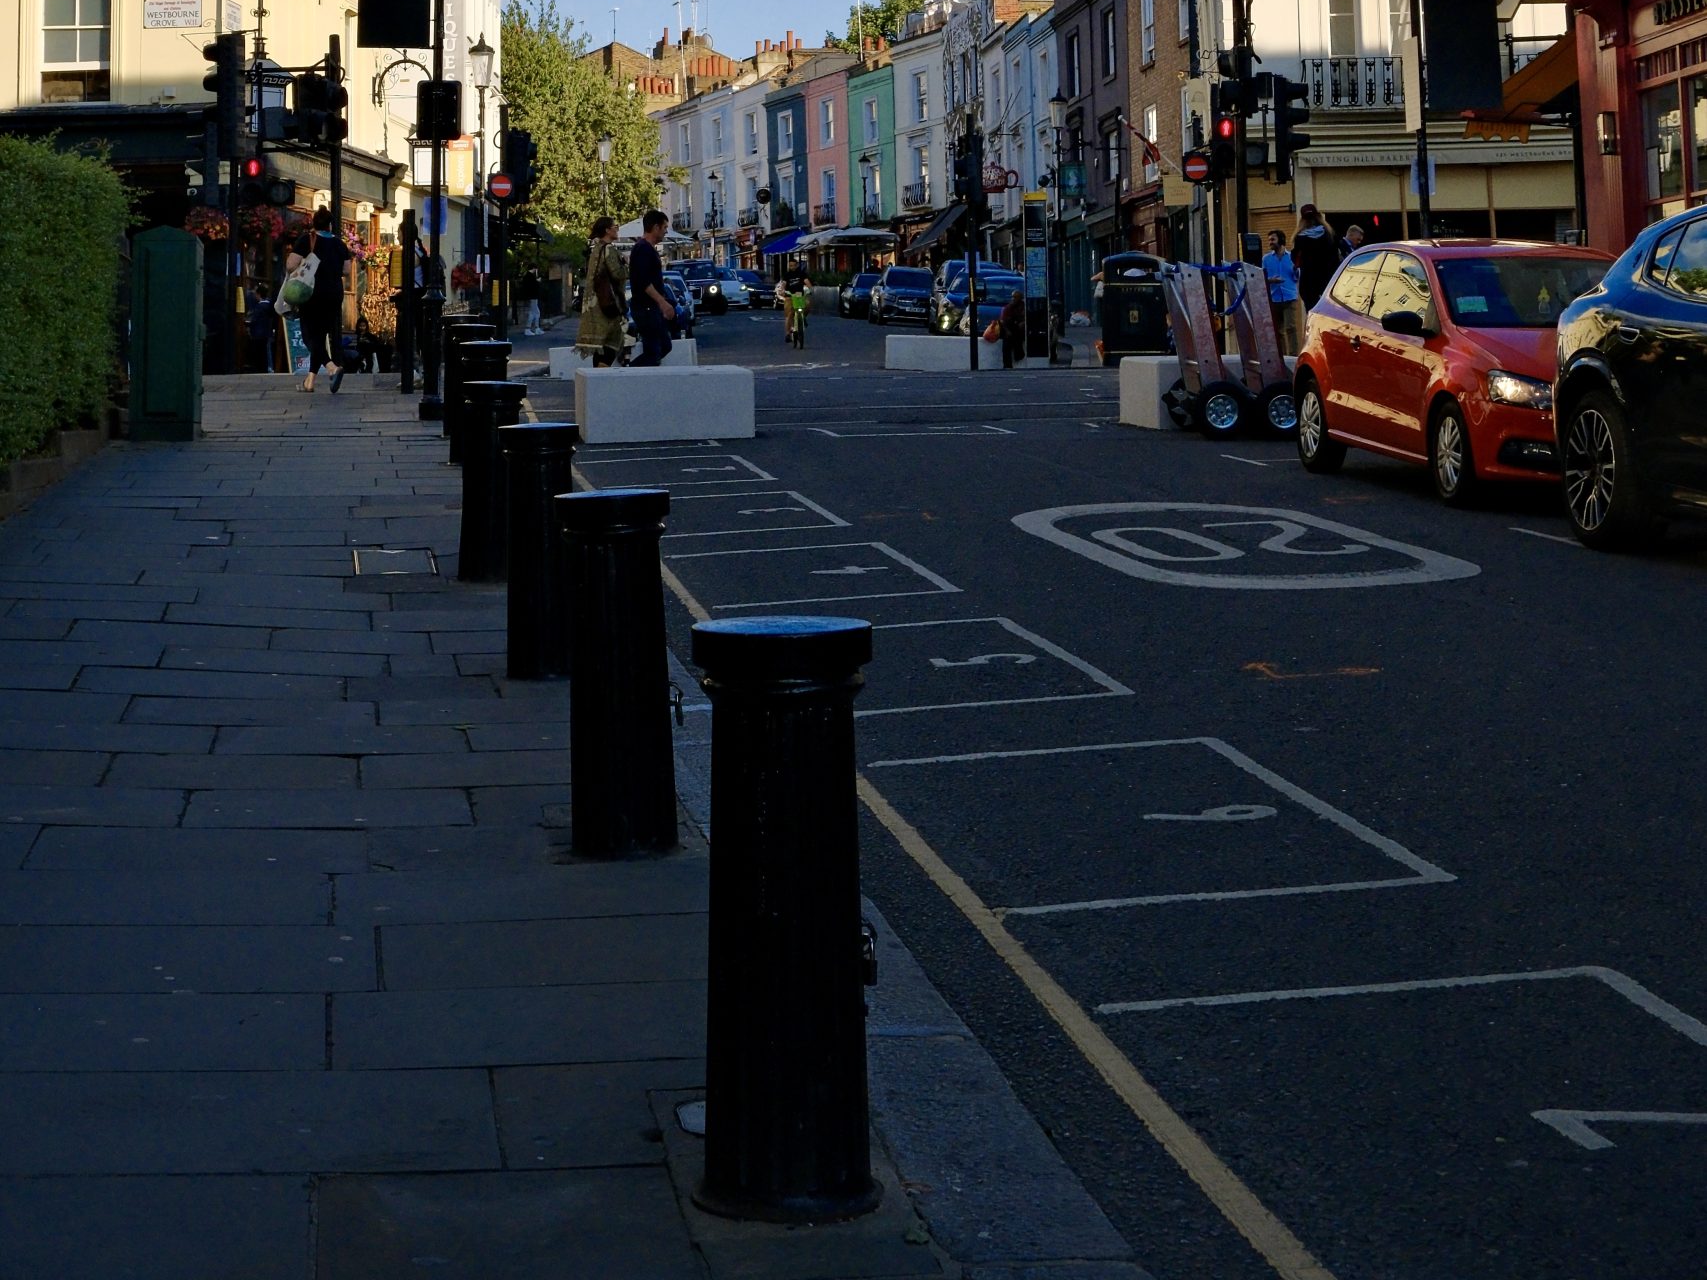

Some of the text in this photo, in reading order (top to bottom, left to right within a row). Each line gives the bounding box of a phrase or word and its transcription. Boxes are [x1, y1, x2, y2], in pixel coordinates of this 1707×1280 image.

[147, 10, 199, 19] WESTBOURNE
[1304, 155, 1350, 164] NOTTING
[1354, 154, 1374, 163] HILL
[1091, 519, 1370, 563] 20
[929, 652, 1037, 669] 5
